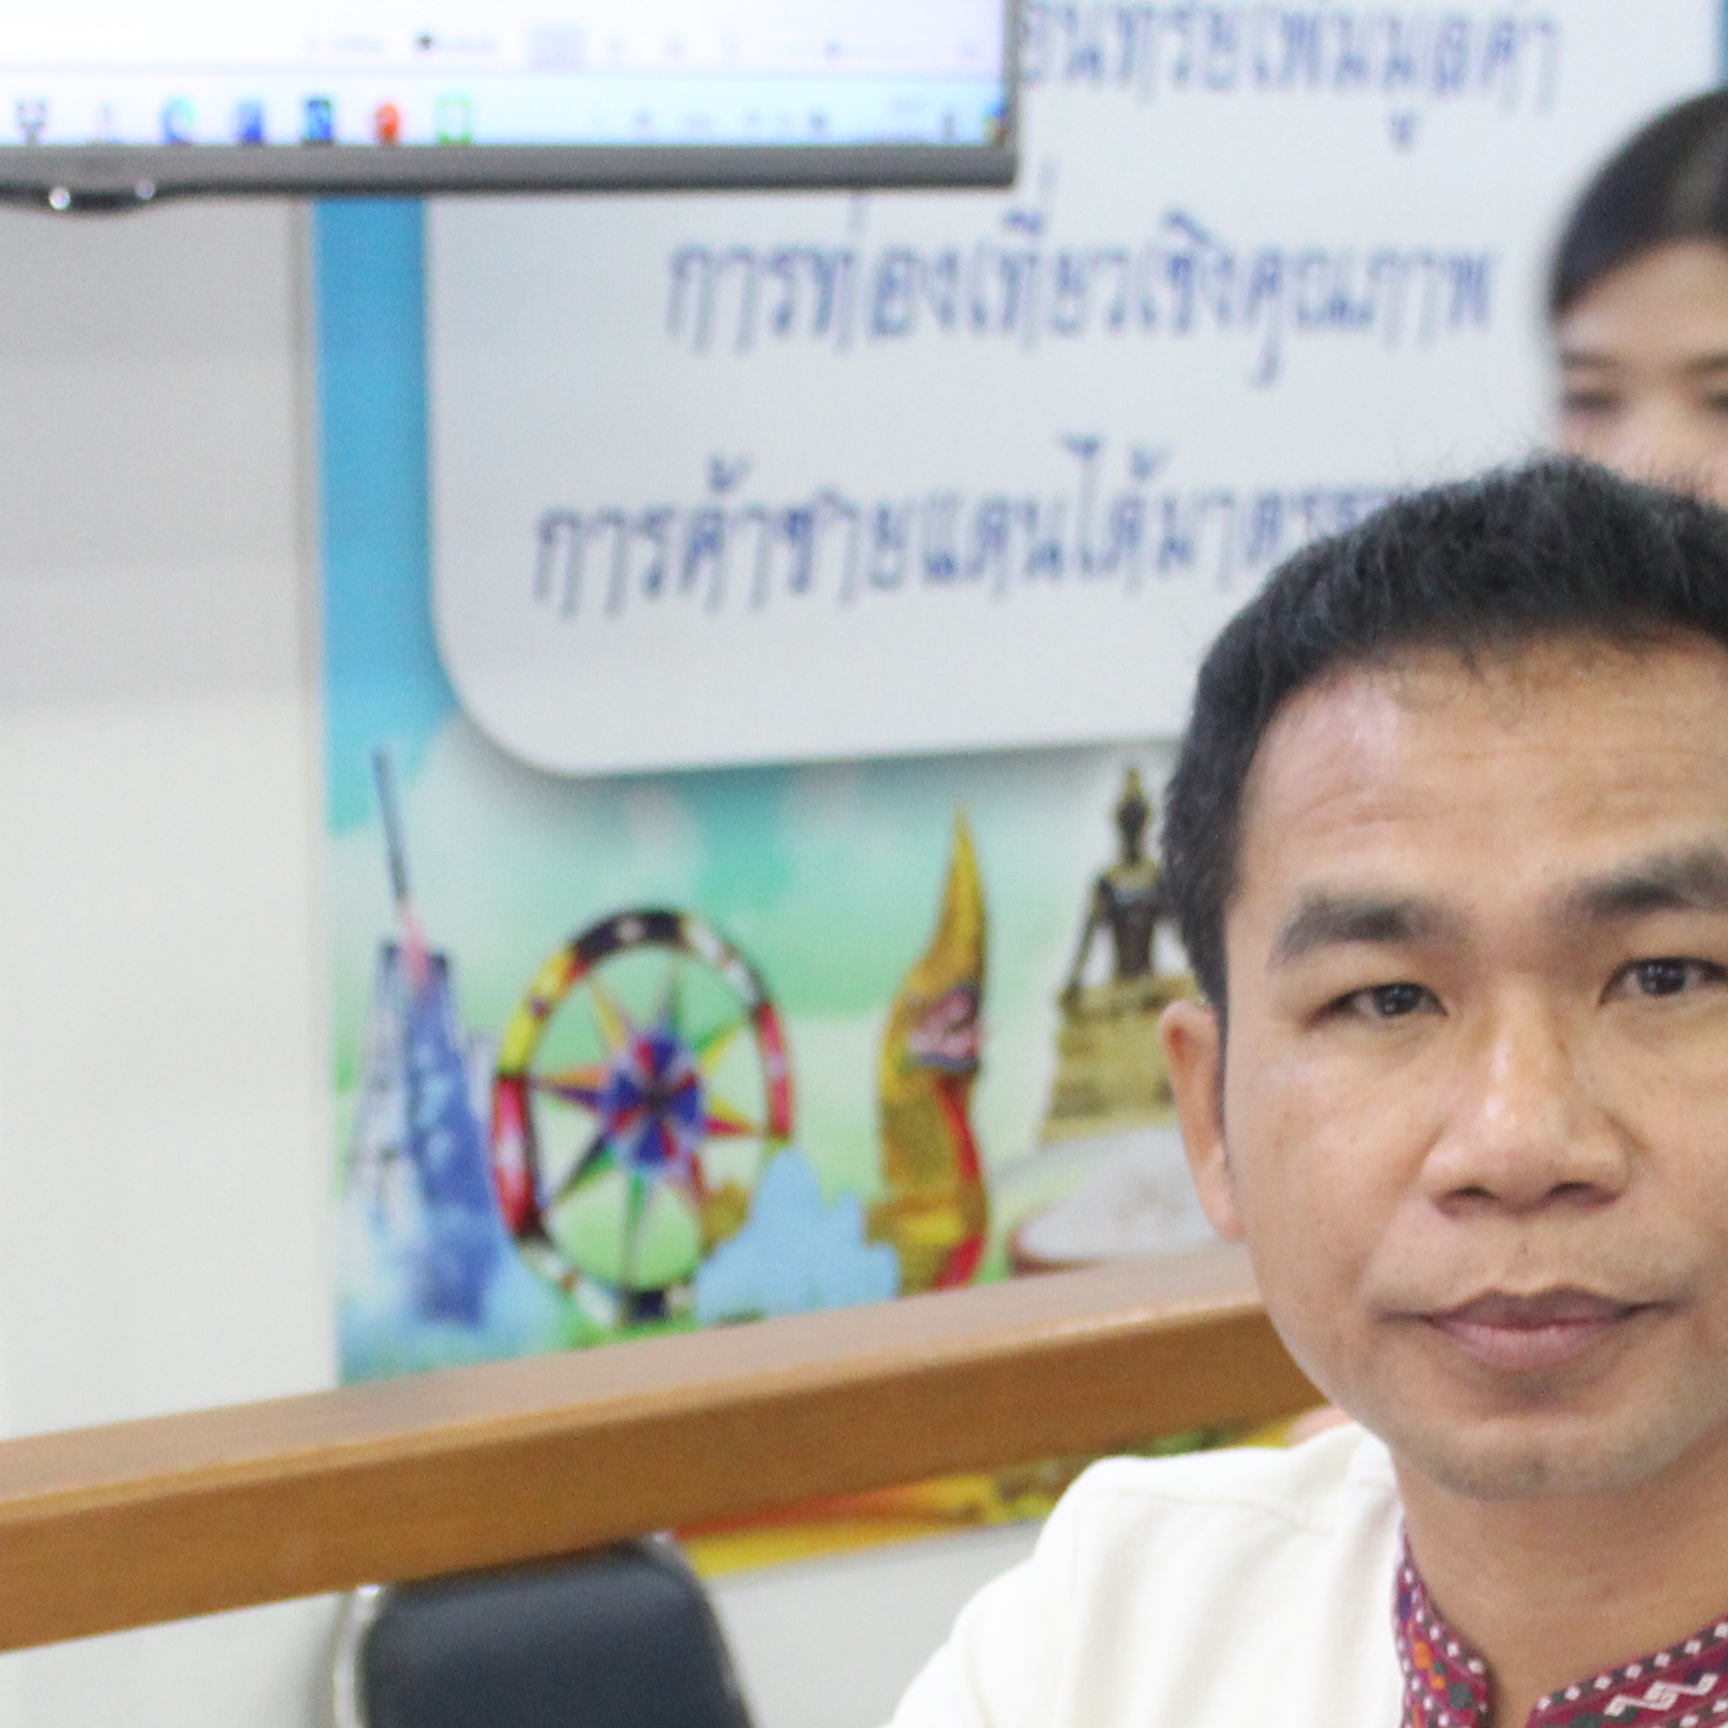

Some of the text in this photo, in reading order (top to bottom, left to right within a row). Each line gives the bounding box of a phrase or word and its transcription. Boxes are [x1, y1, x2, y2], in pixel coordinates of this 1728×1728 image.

[669, 160, 1494, 390] การท่องเที่ยวเชิงคุณภาพ
